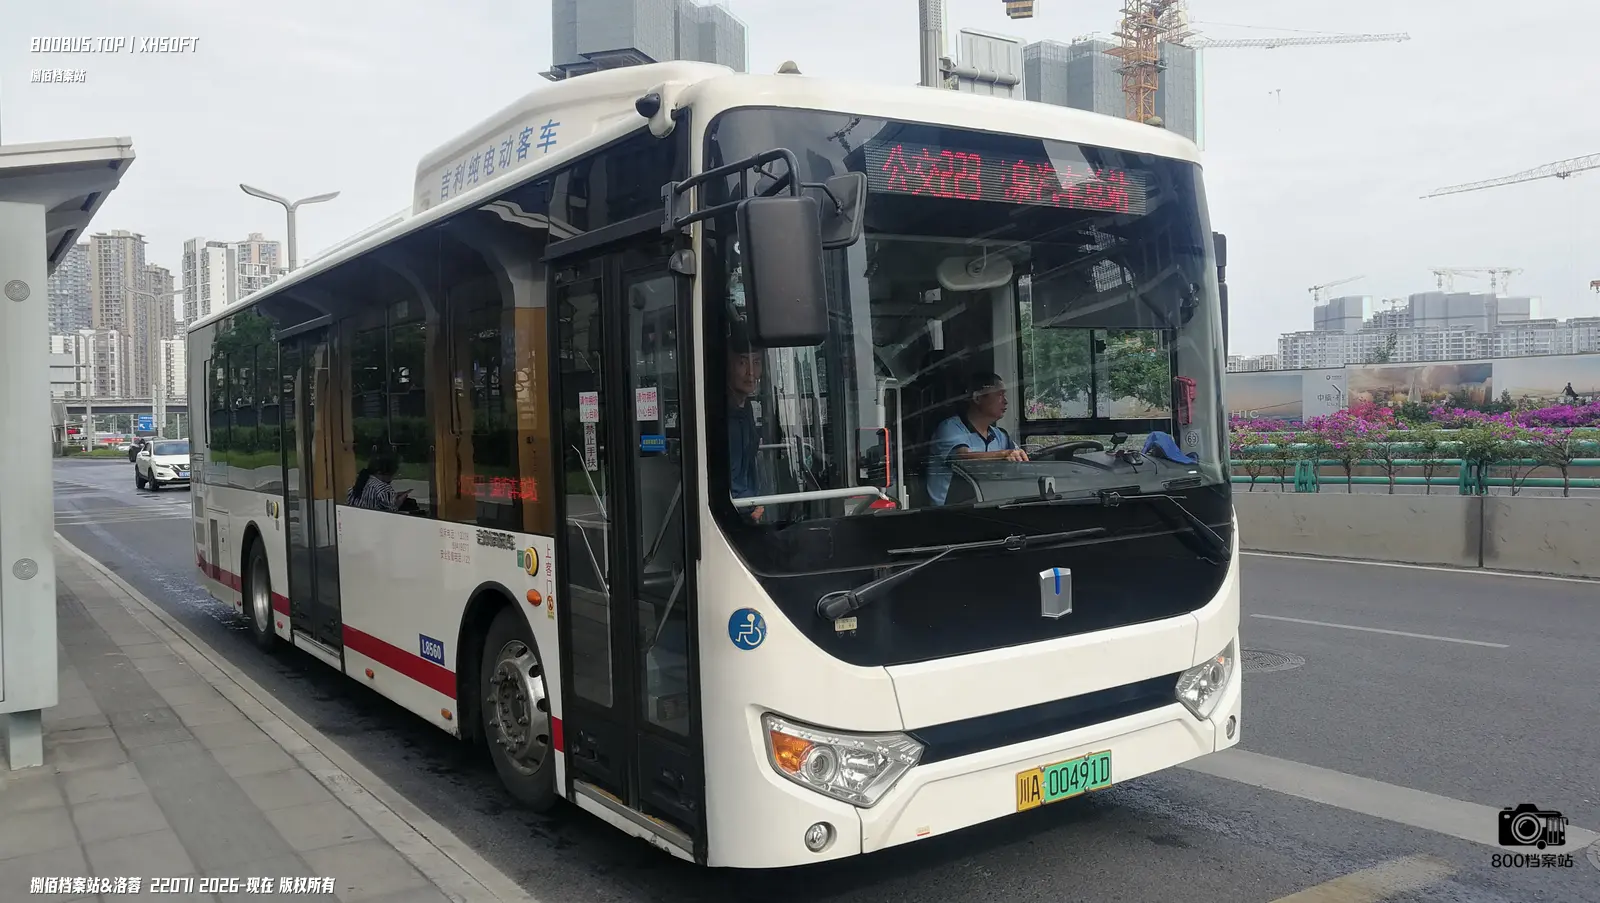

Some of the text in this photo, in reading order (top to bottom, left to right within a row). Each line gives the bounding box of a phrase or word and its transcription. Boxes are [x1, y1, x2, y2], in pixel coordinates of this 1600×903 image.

[440, 119, 561, 201] 吉利纯电动客车
[586, 425, 597, 468] 禁止手扶
[421, 638, 442, 660] L8560
[1020, 756, 1109, 805] 川A 00491D
